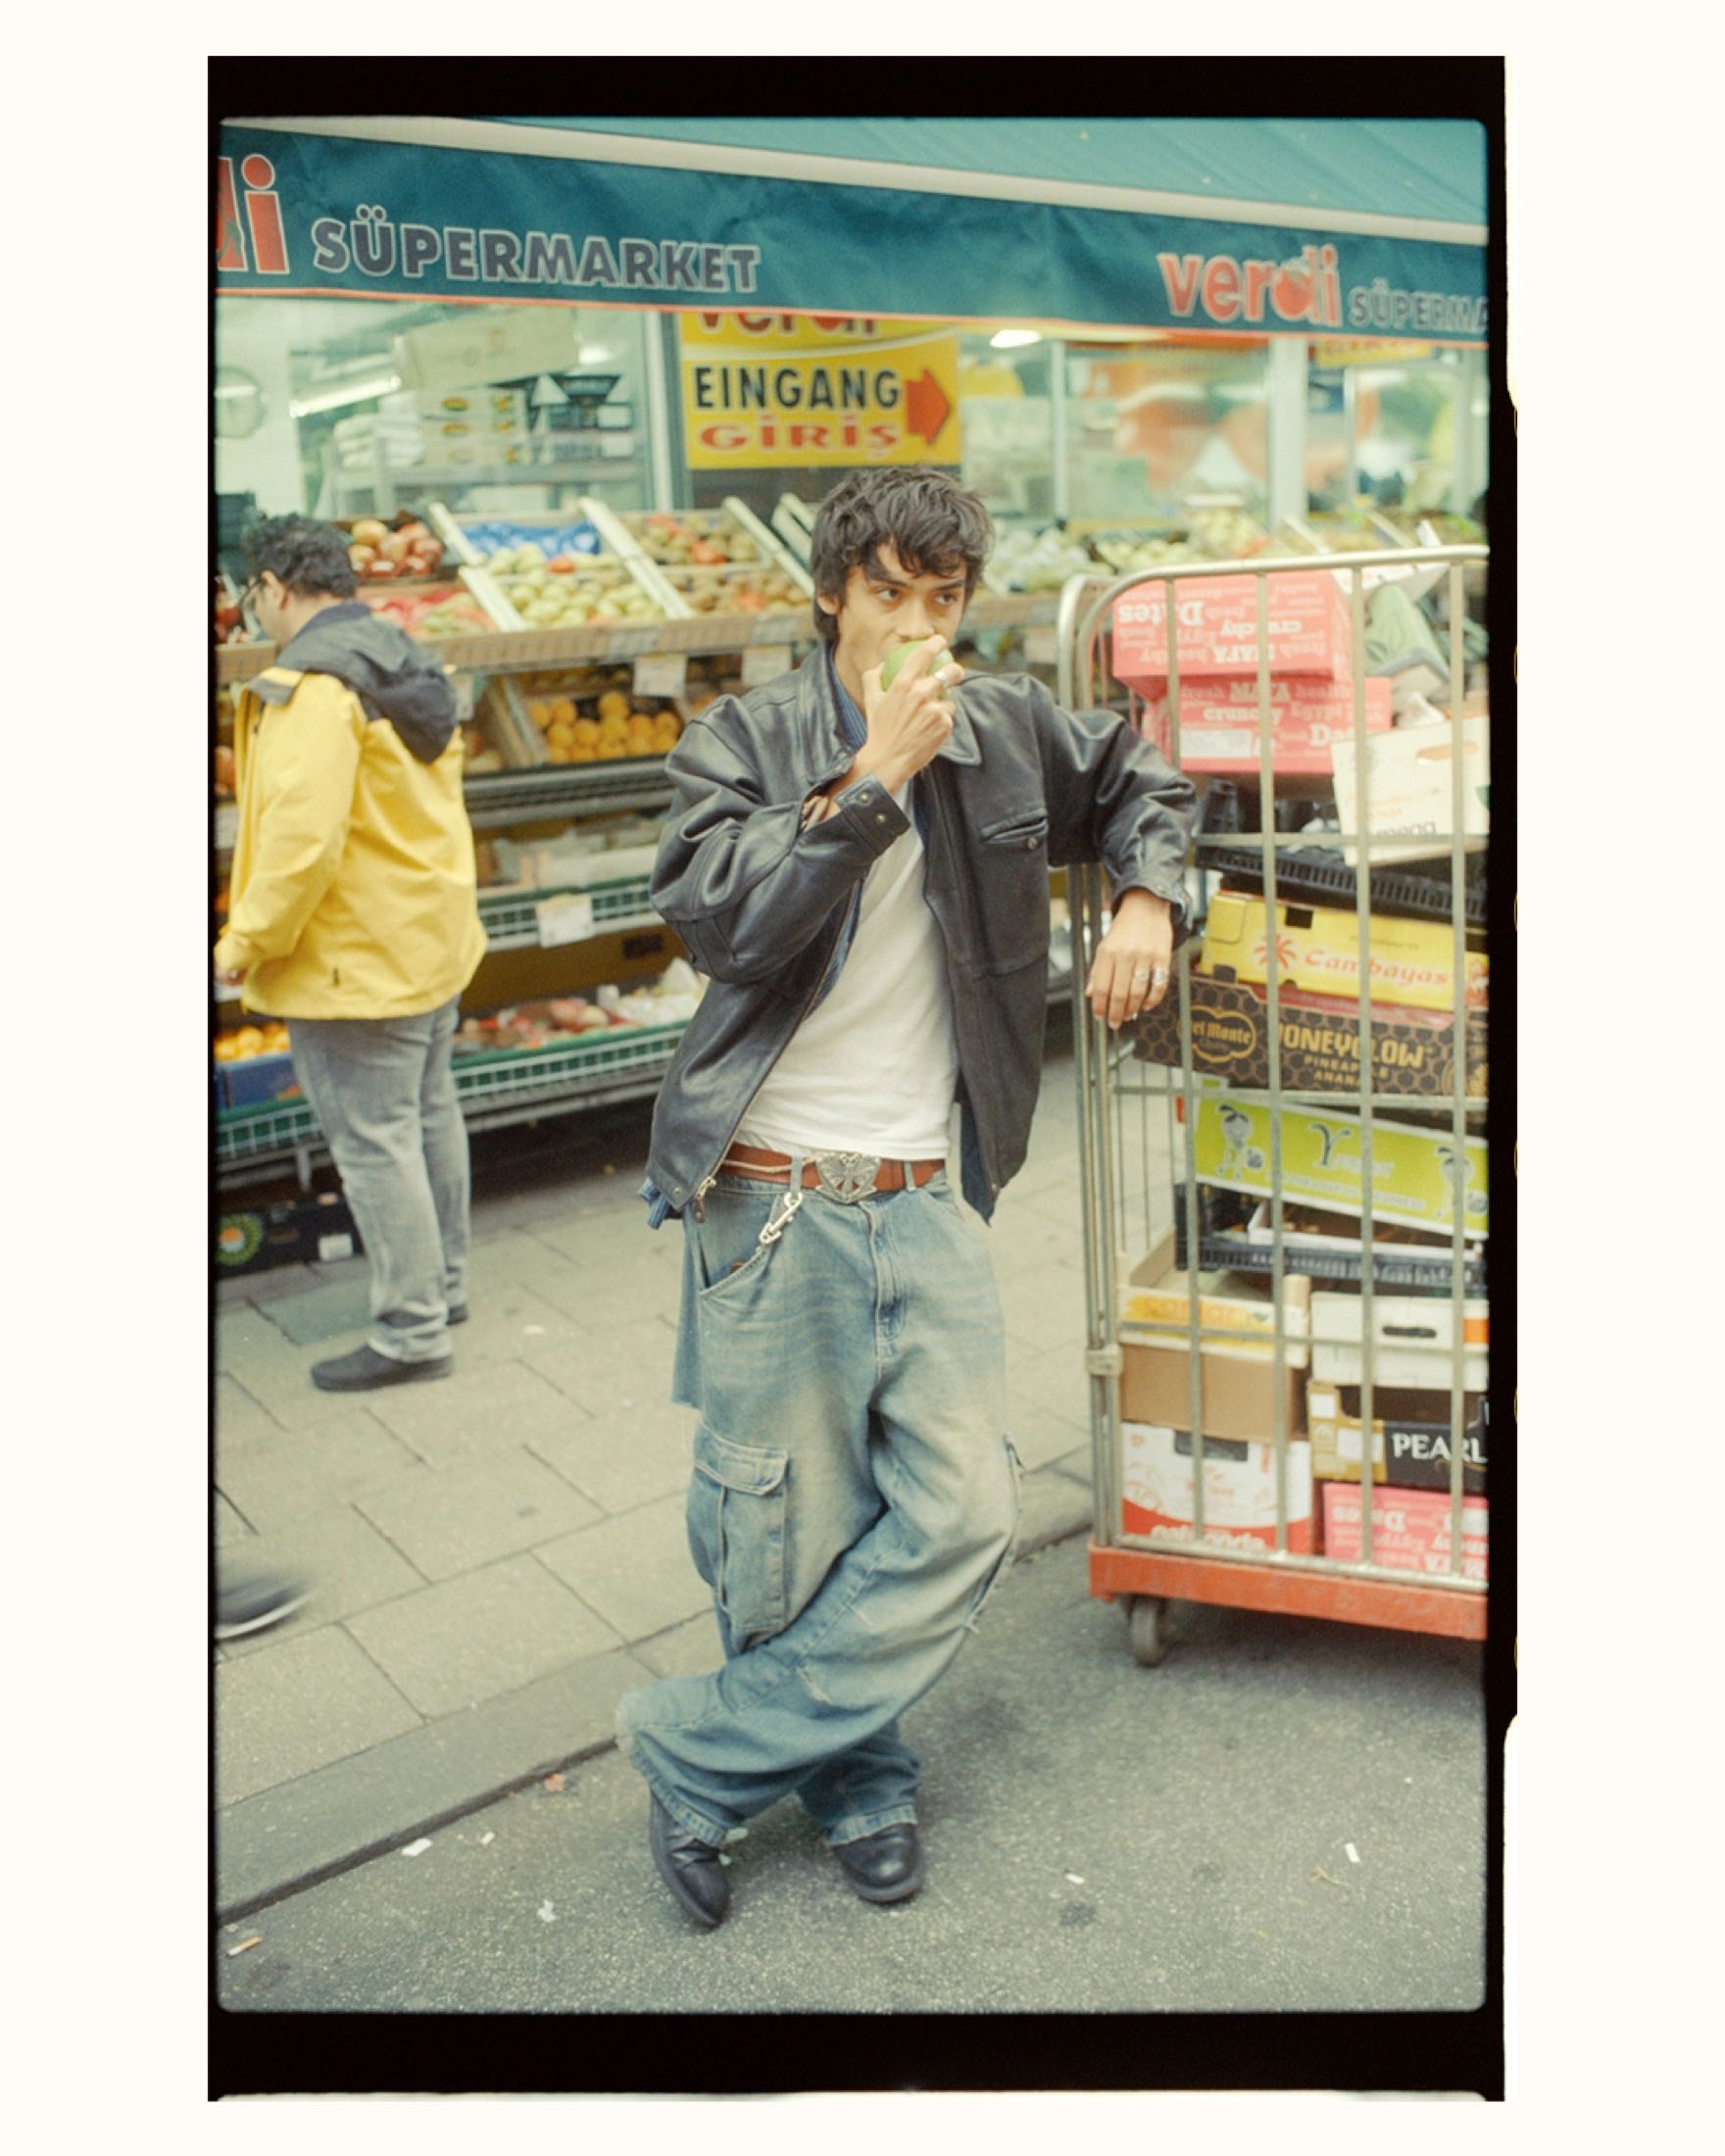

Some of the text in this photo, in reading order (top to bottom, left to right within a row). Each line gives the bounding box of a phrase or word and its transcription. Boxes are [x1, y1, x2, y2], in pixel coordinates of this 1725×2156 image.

[311, 204, 761, 294] SÜPERMARKET
[1157, 243, 1344, 327] verdi
[694, 366, 900, 410] EINGANG
[1117, 601, 1205, 627] Dtes
[1219, 618, 1303, 641] cruchy
[1203, 707, 1286, 726] cruncy
[1305, 1054, 1390, 1079] PINEAPE
[1393, 1432, 1489, 1465] PEARL
[1332, 1505, 1406, 1534] Daes
